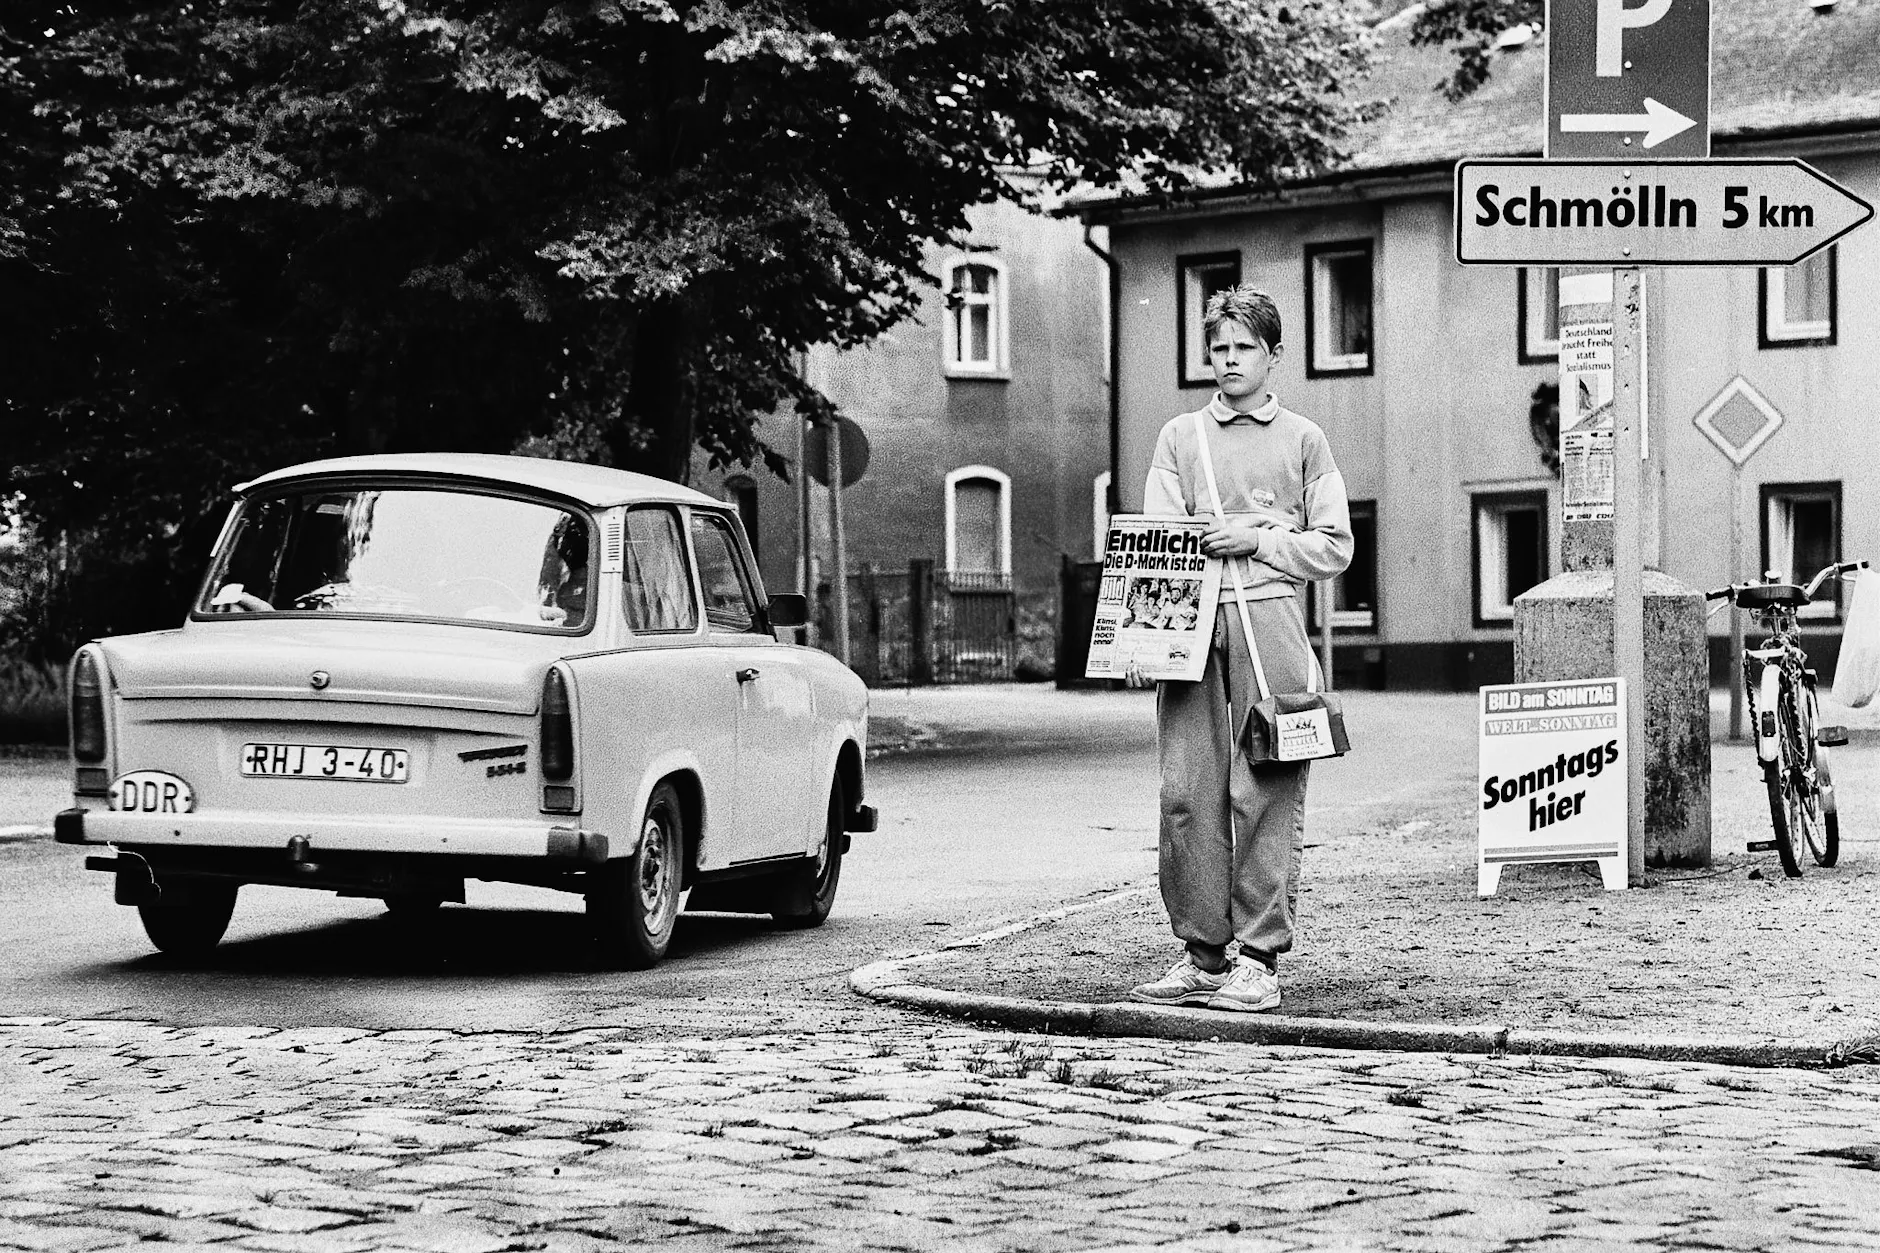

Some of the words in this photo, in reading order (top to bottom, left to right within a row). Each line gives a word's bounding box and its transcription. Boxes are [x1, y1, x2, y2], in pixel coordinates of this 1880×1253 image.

[1475, 184, 1697, 229] Schmölln
[1722, 185, 1749, 229] 5
[1759, 195, 1814, 228] km
[1103, 552, 1123, 569] Die
[1124, 553, 1169, 570] D-Mark
[1170, 554, 1188, 571] ist
[1188, 555, 1206, 572] da
[1488, 691, 1521, 711] BILD
[1522, 693, 1545, 709] am
[1546, 685, 1614, 708] SONNTAG
[1487, 719, 1531, 735] WELT
[1539, 713, 1615, 732] SONNTAG
[252, 745, 305, 775] RHJ
[322, 747, 396, 779] 3-40
[1483, 739, 1619, 811] Sonntags
[122, 779, 179, 813] DDR
[1529, 789, 1586, 833] hier
